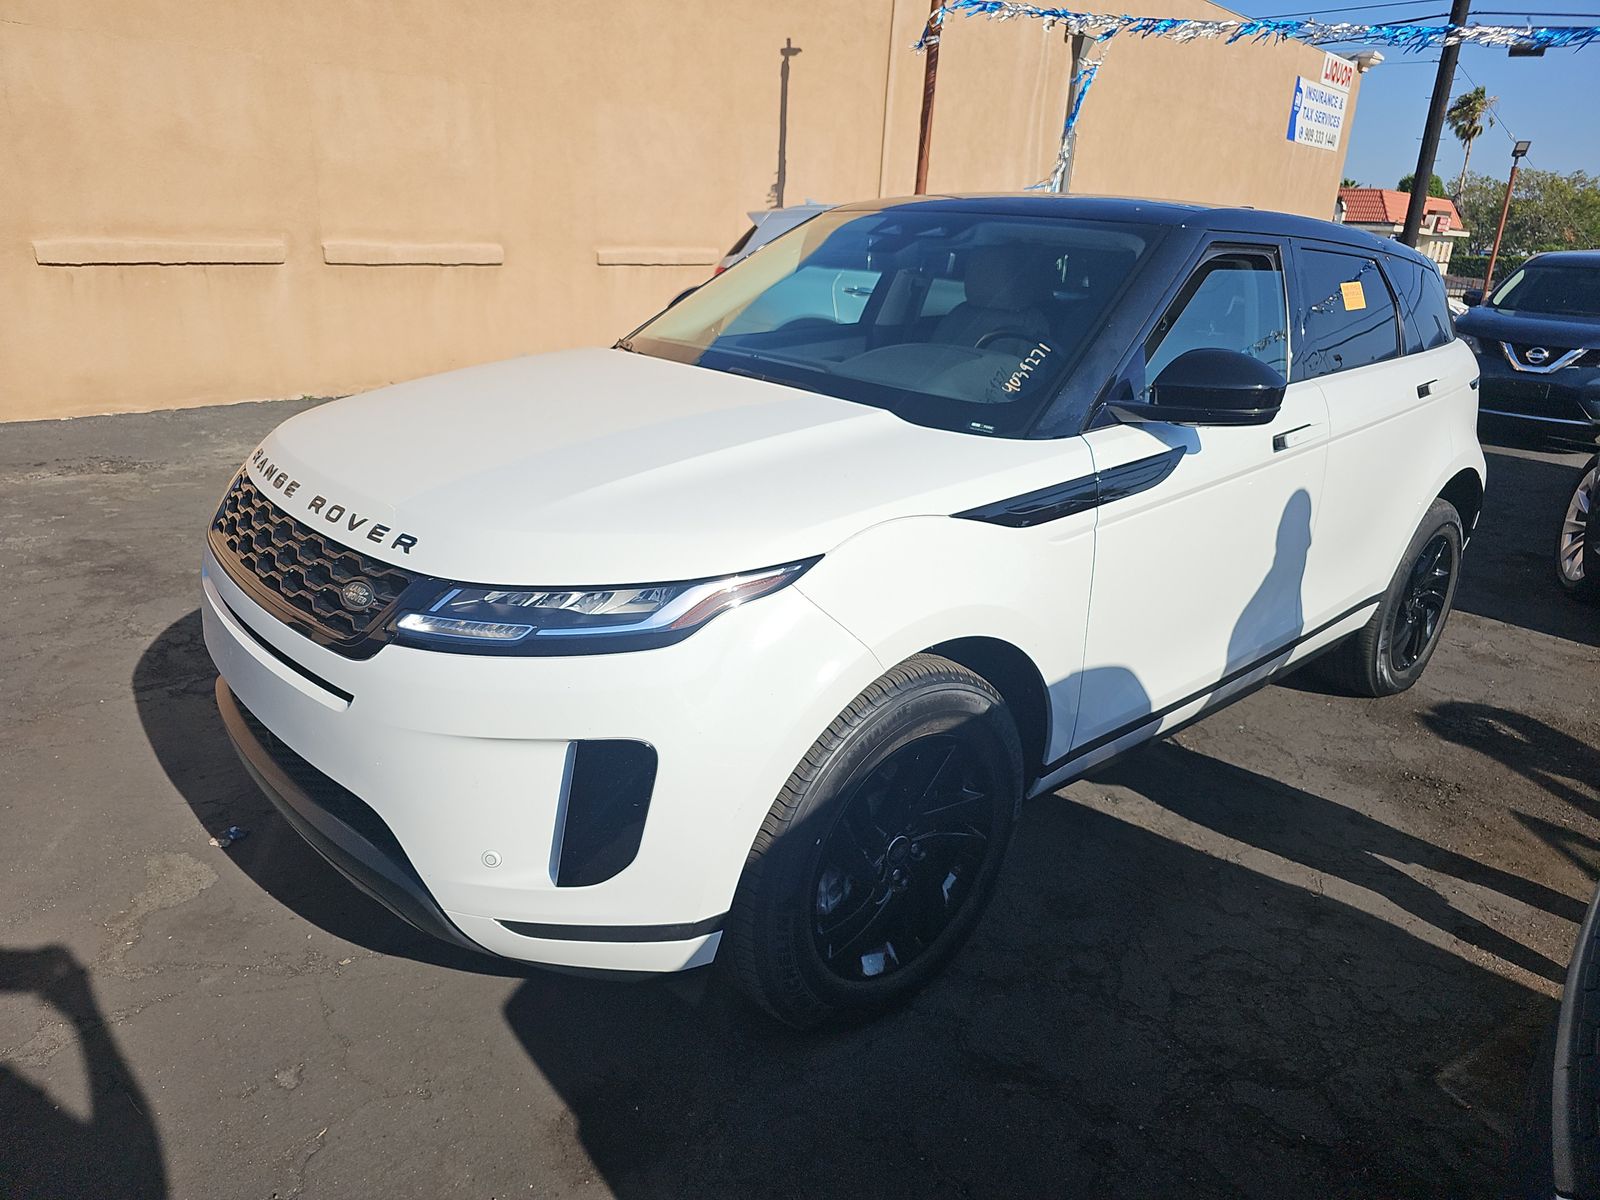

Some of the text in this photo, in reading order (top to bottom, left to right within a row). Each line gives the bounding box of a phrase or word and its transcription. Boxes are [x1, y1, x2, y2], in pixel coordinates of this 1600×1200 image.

[1324, 58, 1352, 88] LIQUOR
[1305, 85, 1339, 108] INSURANCE
[1338, 97, 1344, 110] &
[1302, 106, 1341, 129] TAX SERVICES
[1001, 343, 1051, 392] 4039271
[252, 448, 418, 555] RANGE ROVER
[346, 591, 368, 606] ROVER
[349, 584, 366, 596] LAND
